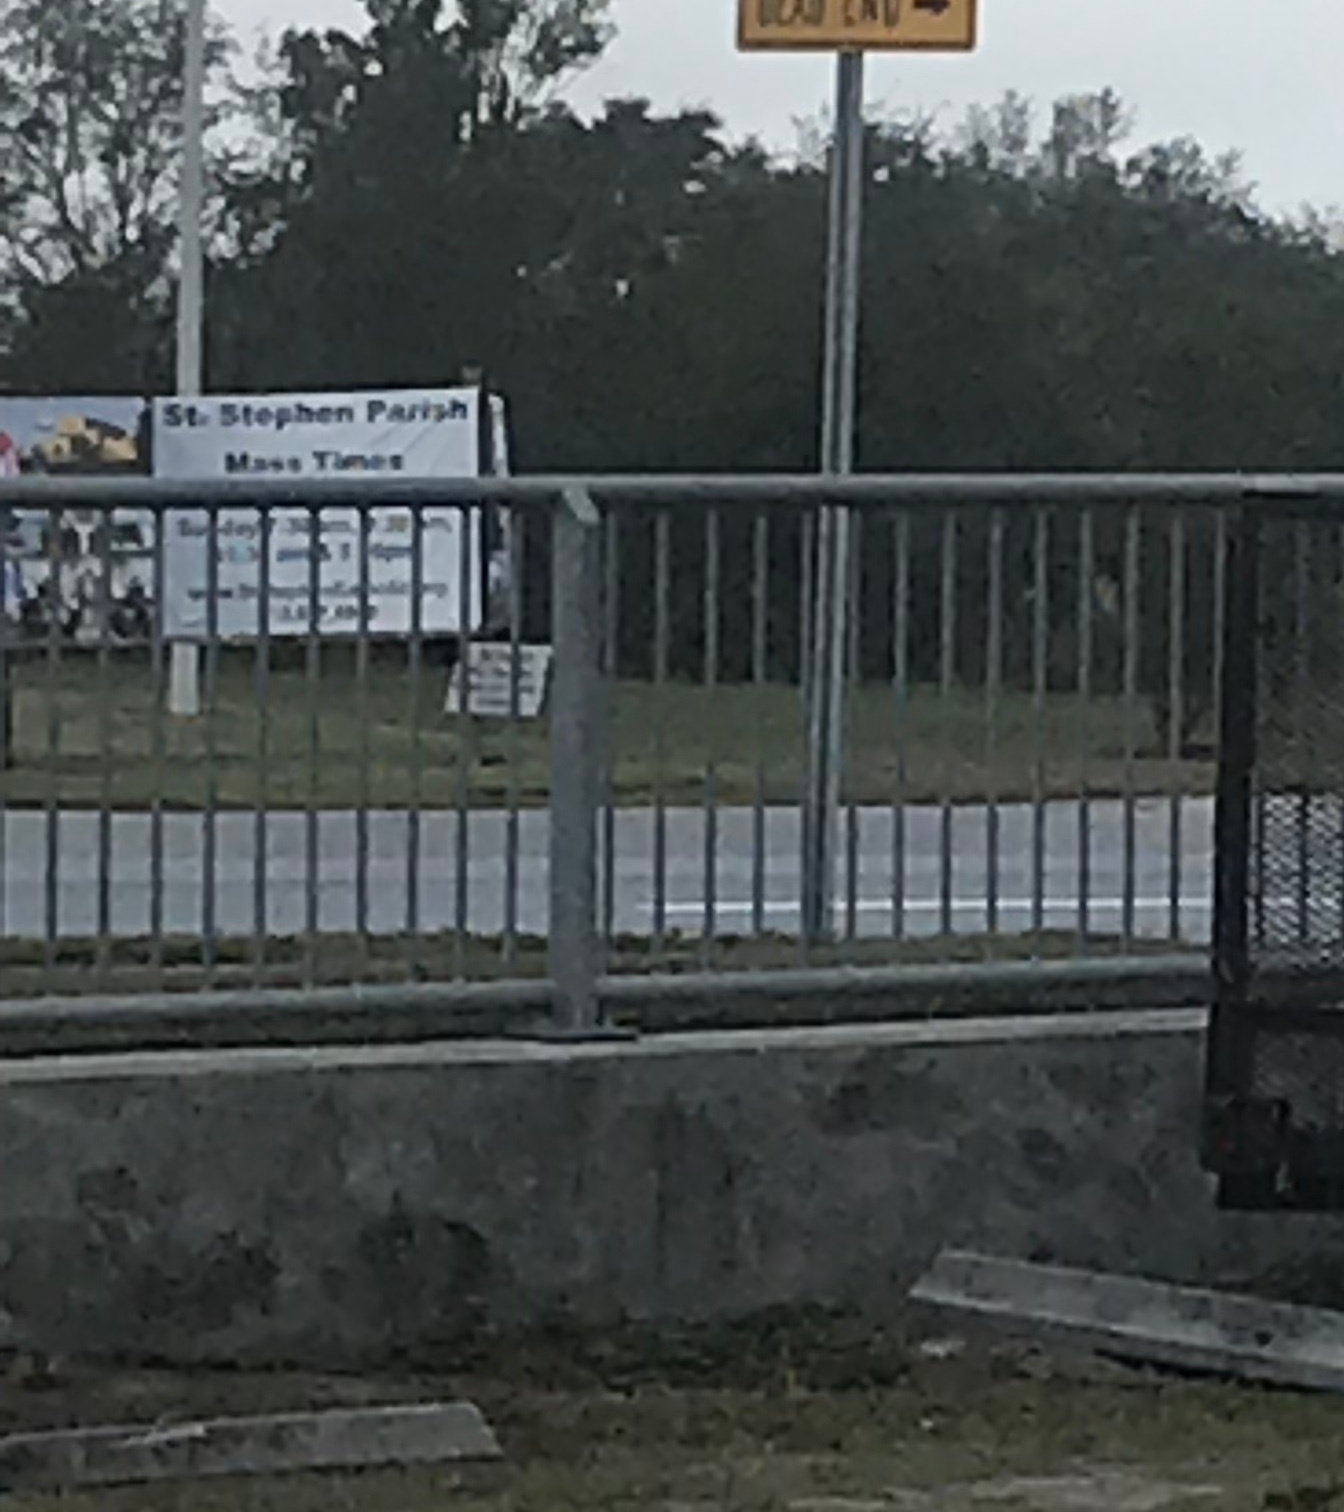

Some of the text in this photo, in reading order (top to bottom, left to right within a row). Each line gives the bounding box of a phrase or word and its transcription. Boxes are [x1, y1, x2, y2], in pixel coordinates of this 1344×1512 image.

[163, 397, 468, 430] St. Stephen Parish
[224, 449, 404, 474] Mass Times
